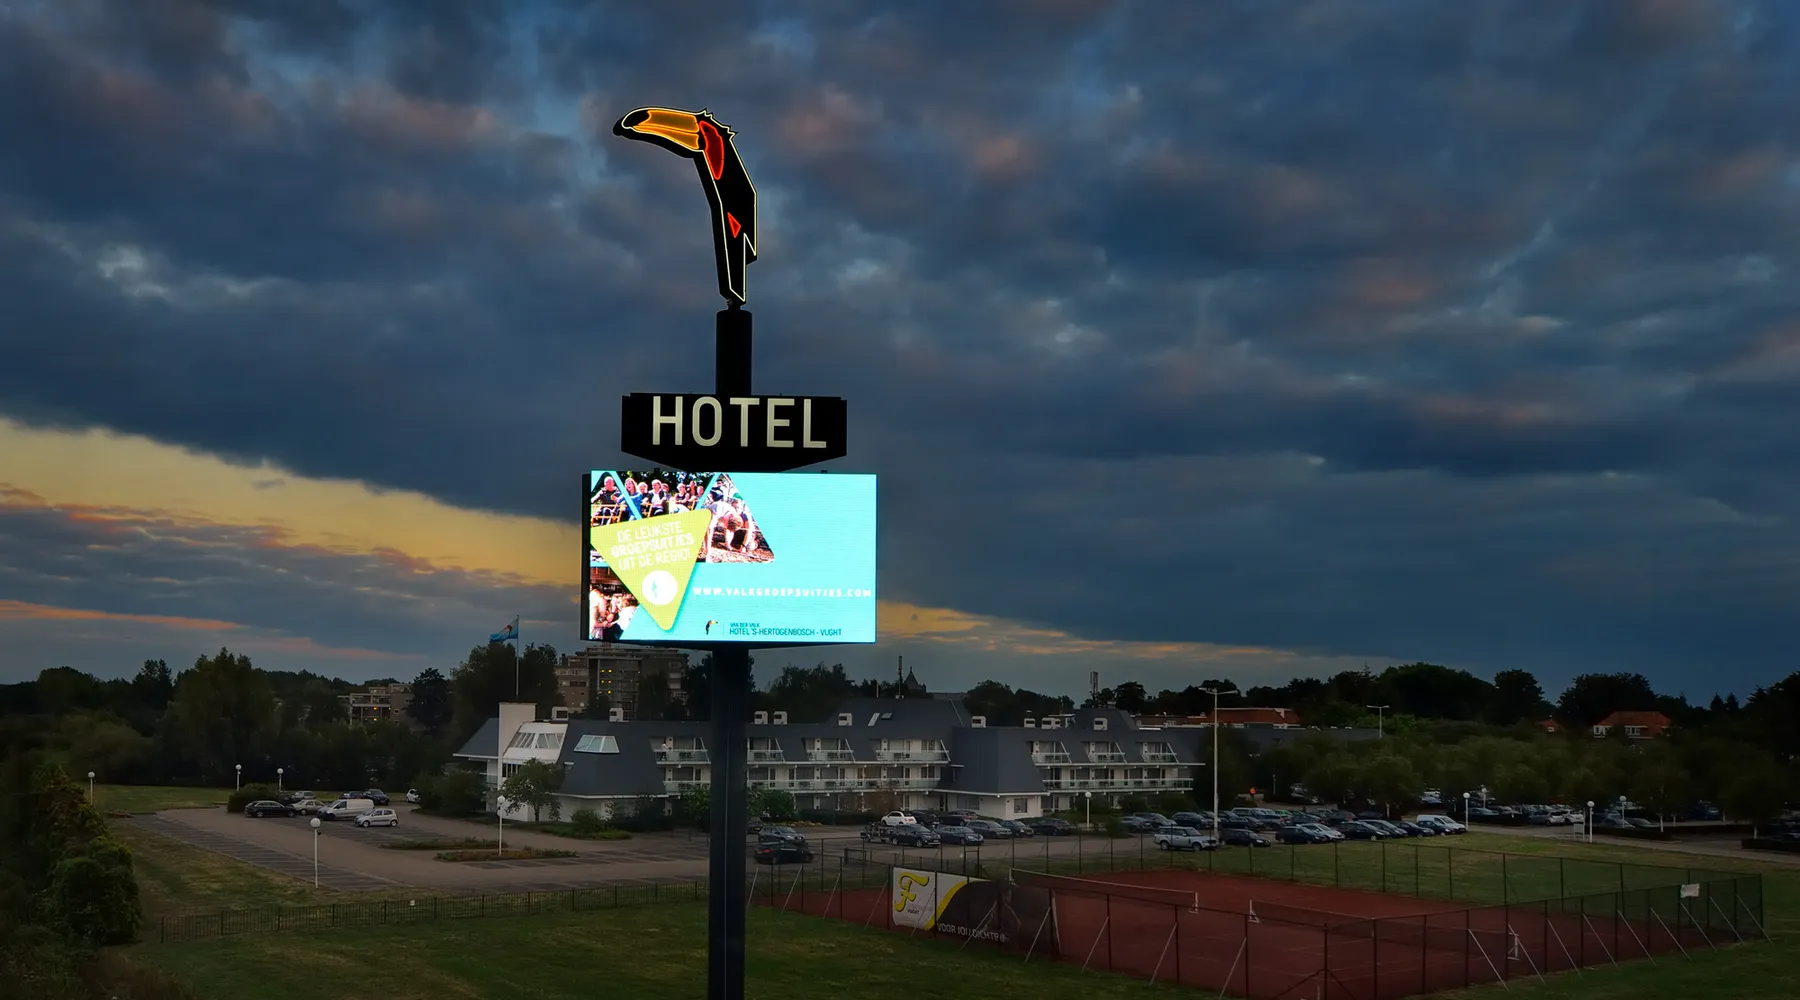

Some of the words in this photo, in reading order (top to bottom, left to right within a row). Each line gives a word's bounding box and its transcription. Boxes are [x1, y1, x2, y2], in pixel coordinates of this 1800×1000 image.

[652, 396, 827, 448] HOTEL
[617, 530, 632, 543] DE
[635, 521, 683, 540] LEUKSTE
[611, 533, 694, 558] GROEPSUITJES
[618, 557, 635, 570] UIT
[638, 554, 653, 567] DE
[656, 548, 691, 564] REGIO!
[692, 587, 873, 598] WWW.VALKGROEPSUITJES.COM
[751, 628, 815, 636] 'S-HERTOGENBOSCH
[820, 628, 842, 636] VUGHT
[937, 922, 957, 934] VOOR
